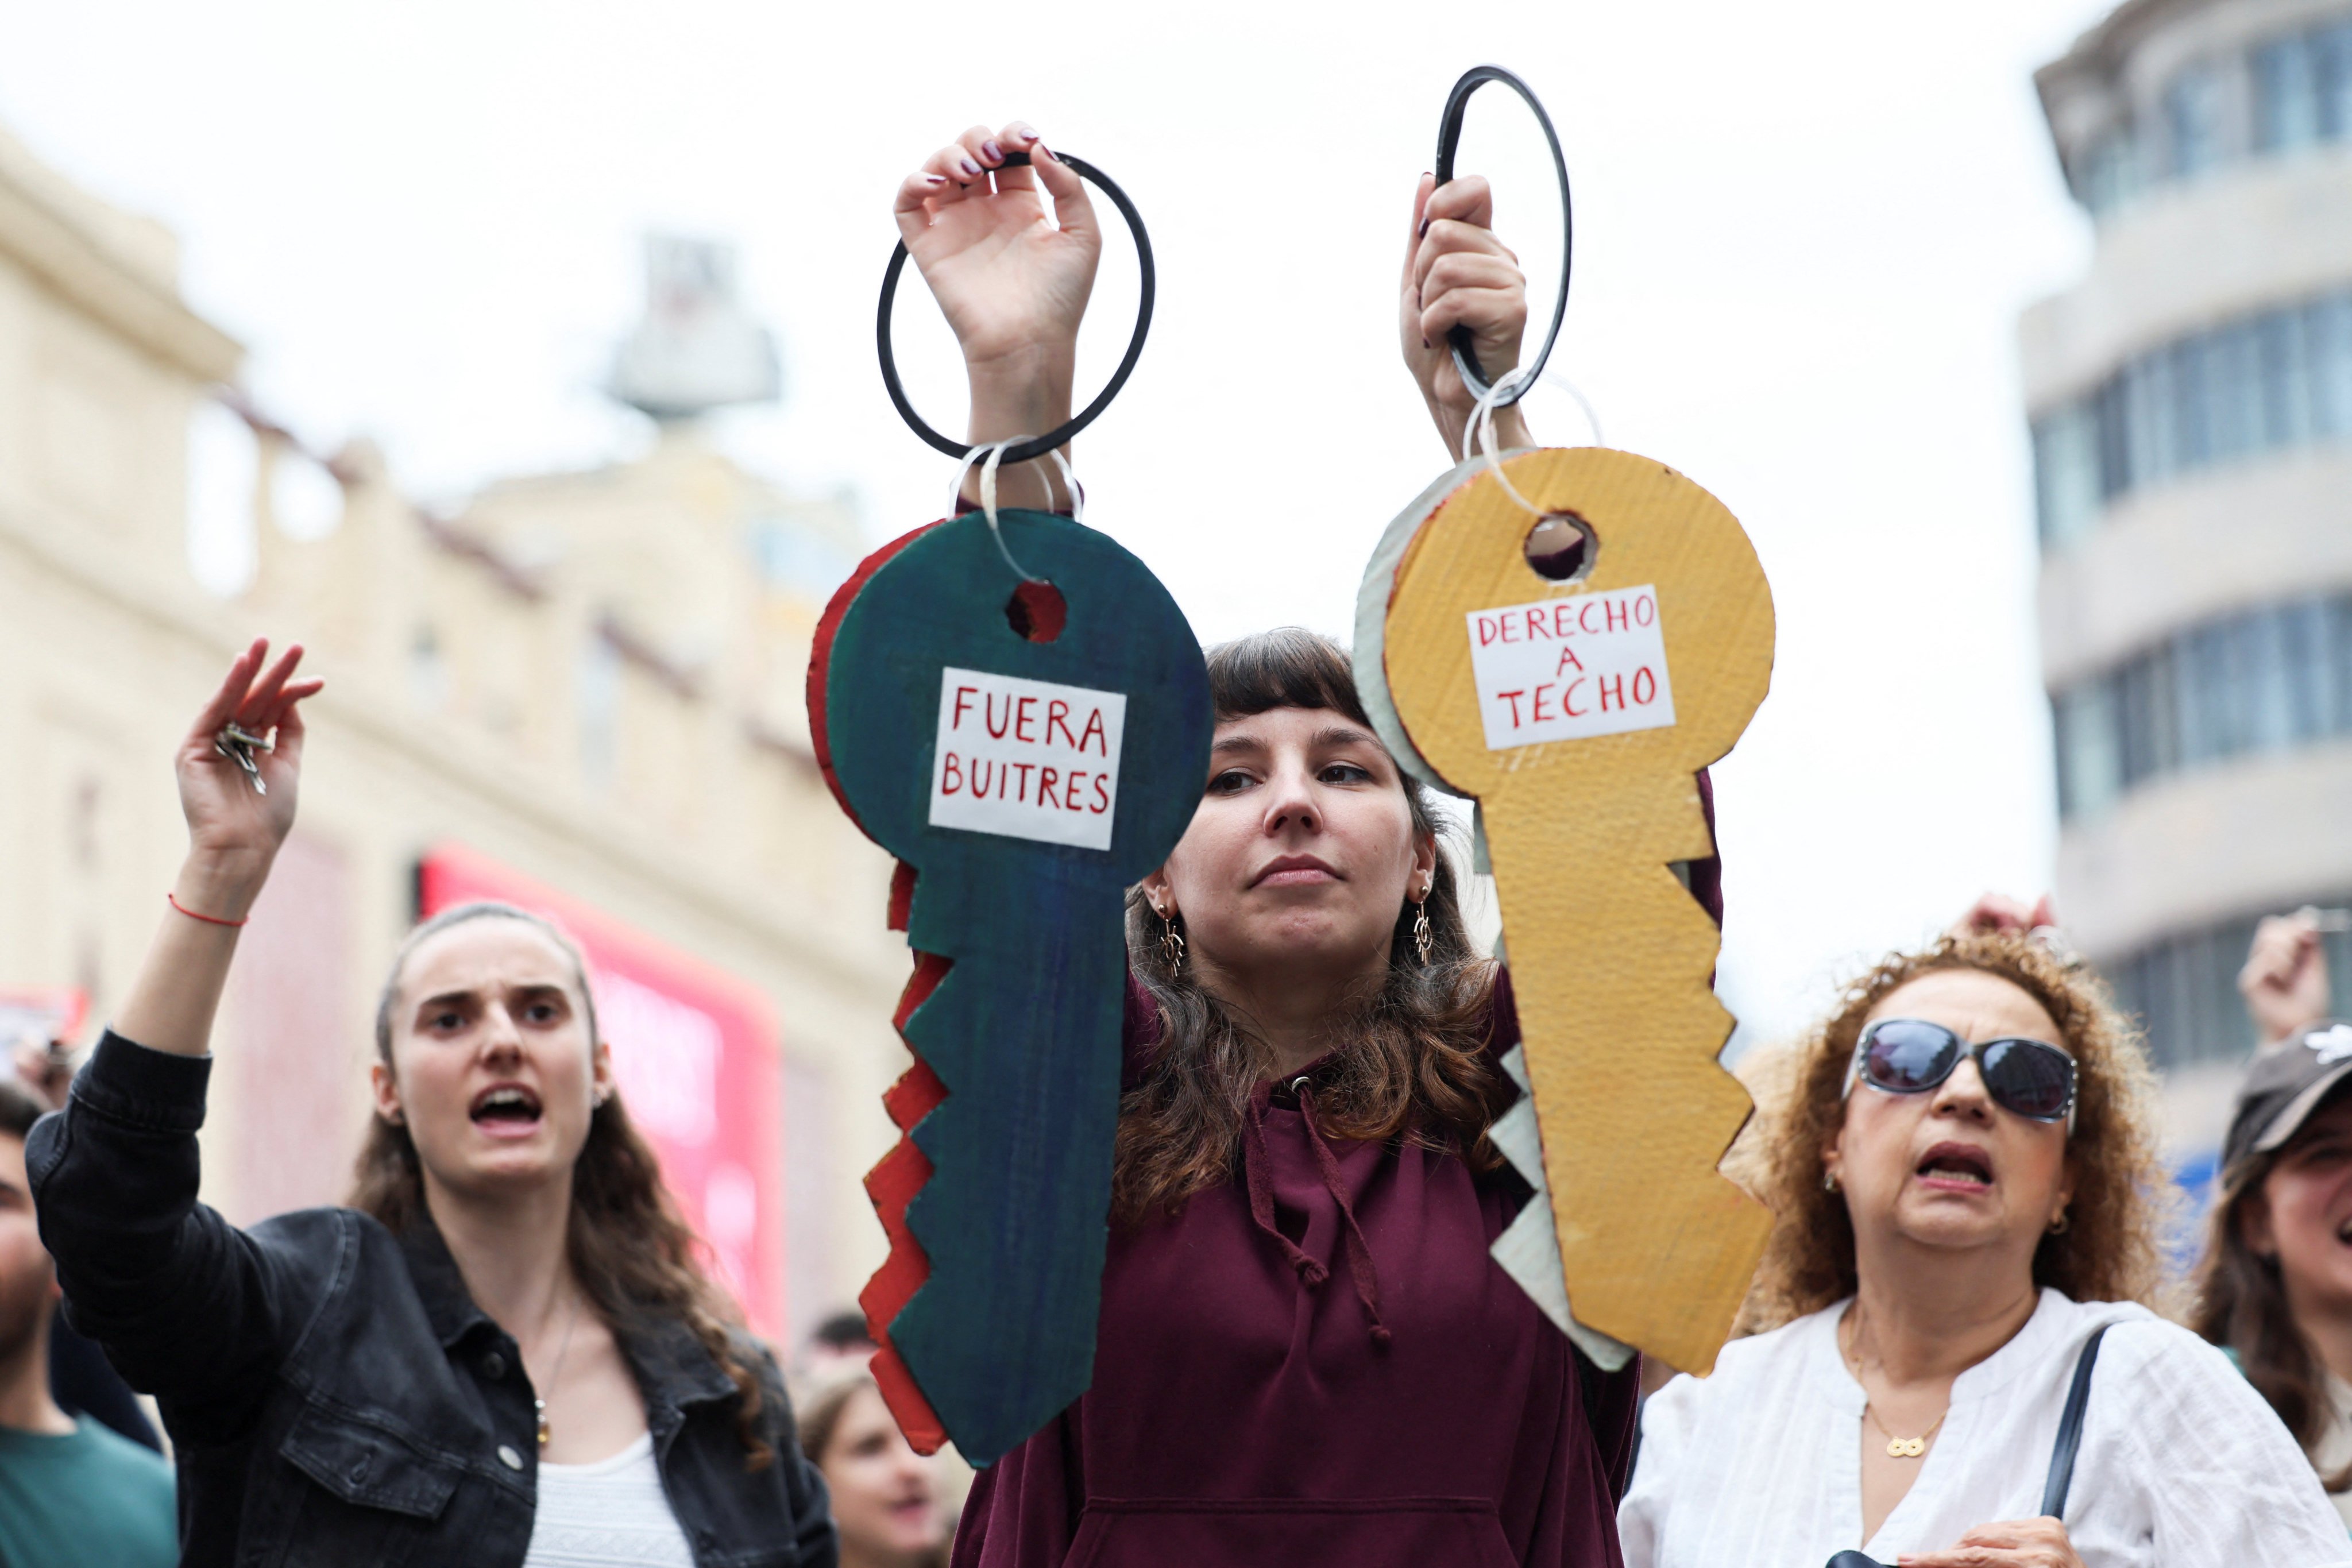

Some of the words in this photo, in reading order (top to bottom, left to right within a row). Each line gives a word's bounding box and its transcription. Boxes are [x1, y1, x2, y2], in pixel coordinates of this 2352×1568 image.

[1478, 595, 1655, 647] DERECHO
[1557, 646, 1584, 677] A
[952, 686, 1107, 758] FUERA
[1497, 666, 1656, 729] TECHO
[942, 752, 1109, 814] BUITRES
